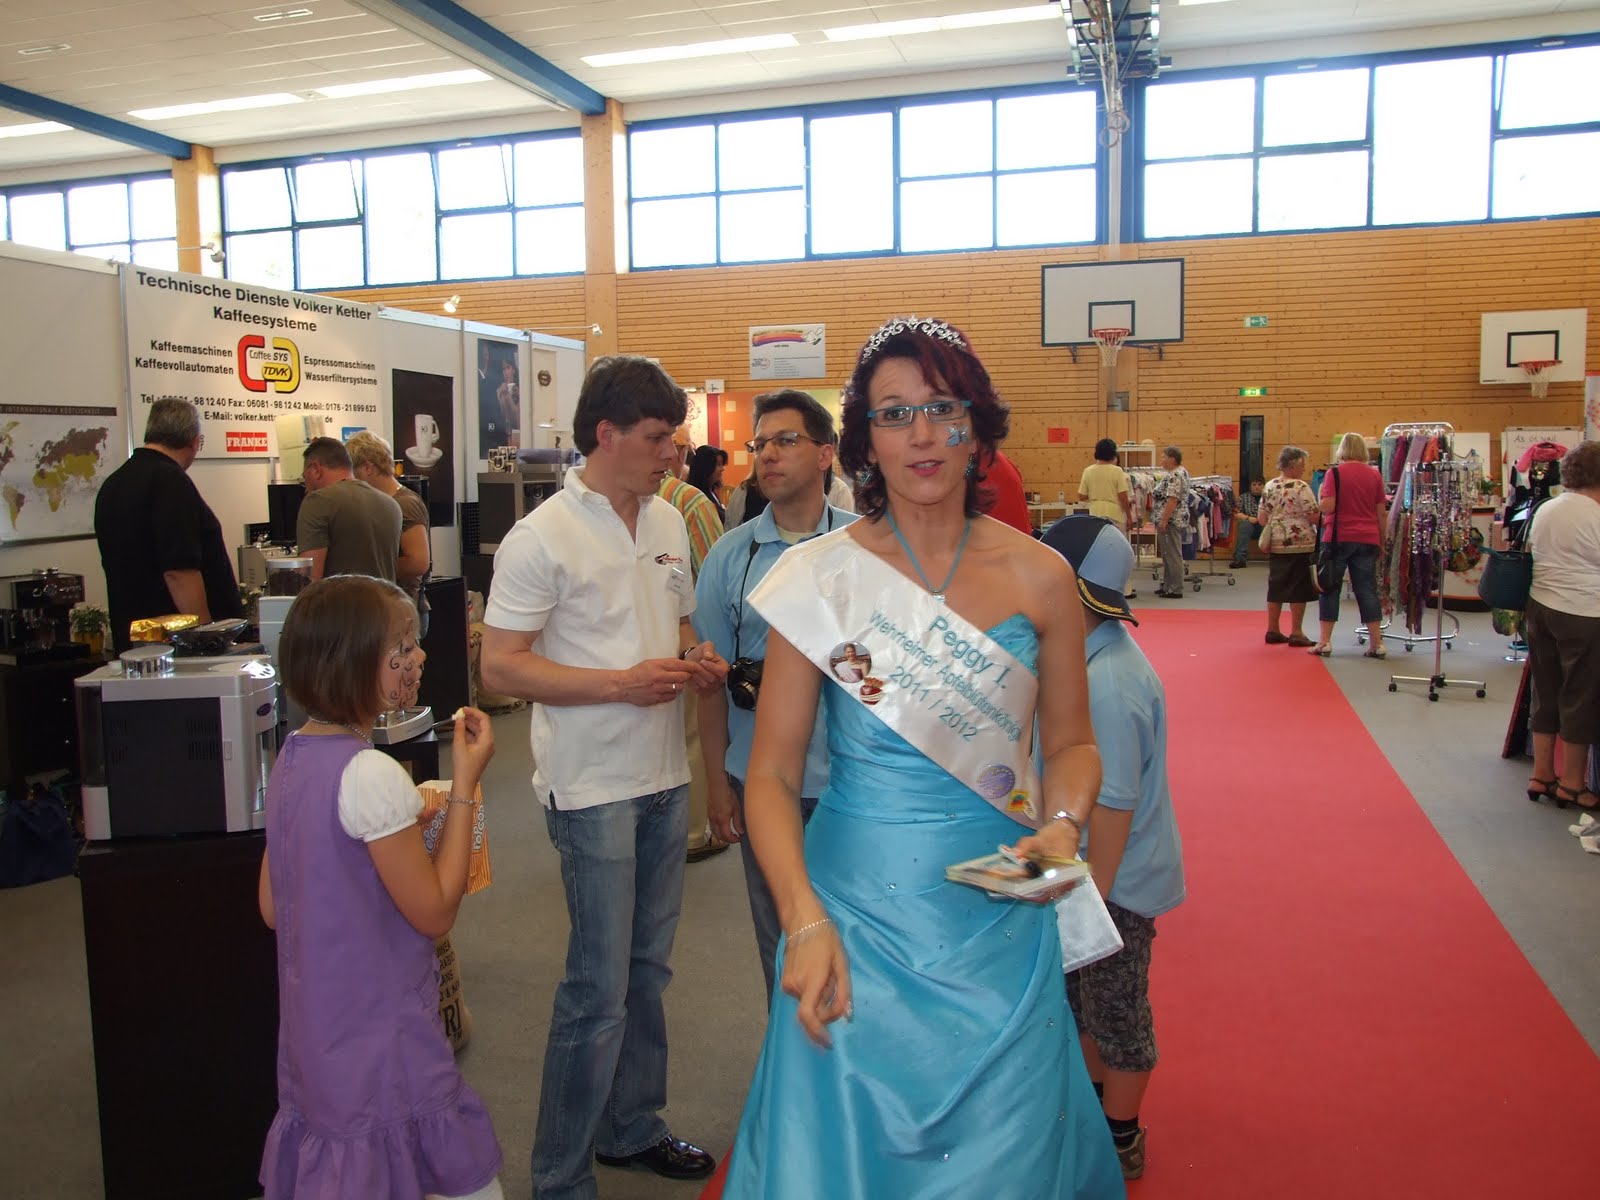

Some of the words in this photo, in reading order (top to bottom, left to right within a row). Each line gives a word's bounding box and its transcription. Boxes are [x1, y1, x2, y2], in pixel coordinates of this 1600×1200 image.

[136, 271, 232, 299] Technische
[235, 288, 290, 308] Dienste
[293, 297, 333, 315] Volker
[336, 304, 371, 321] Ketter
[213, 306, 317, 332] Kaffeesysteme
[150, 340, 233, 358] Kaffeemaschinen
[273, 352, 289, 362] SYS
[135, 357, 234, 375] Kaffeevollautomaten
[263, 366, 289, 377] TDVK
[304, 355, 376, 371] Espressomaschinen
[304, 371, 378, 386] Wasserfiltersysteme
[228, 398, 246, 408] Fax:
[303, 402, 325, 411] Mobil:
[204, 410, 233, 421] E-Mail:
[226, 437, 268, 448] FRANKE
[868, 610, 939, 668] Wehrheimer
[929, 615, 994, 674] Peggy
[888, 665, 931, 703] 2011
[938, 706, 979, 742] 2012
[439, 998, 462, 1037] RI
